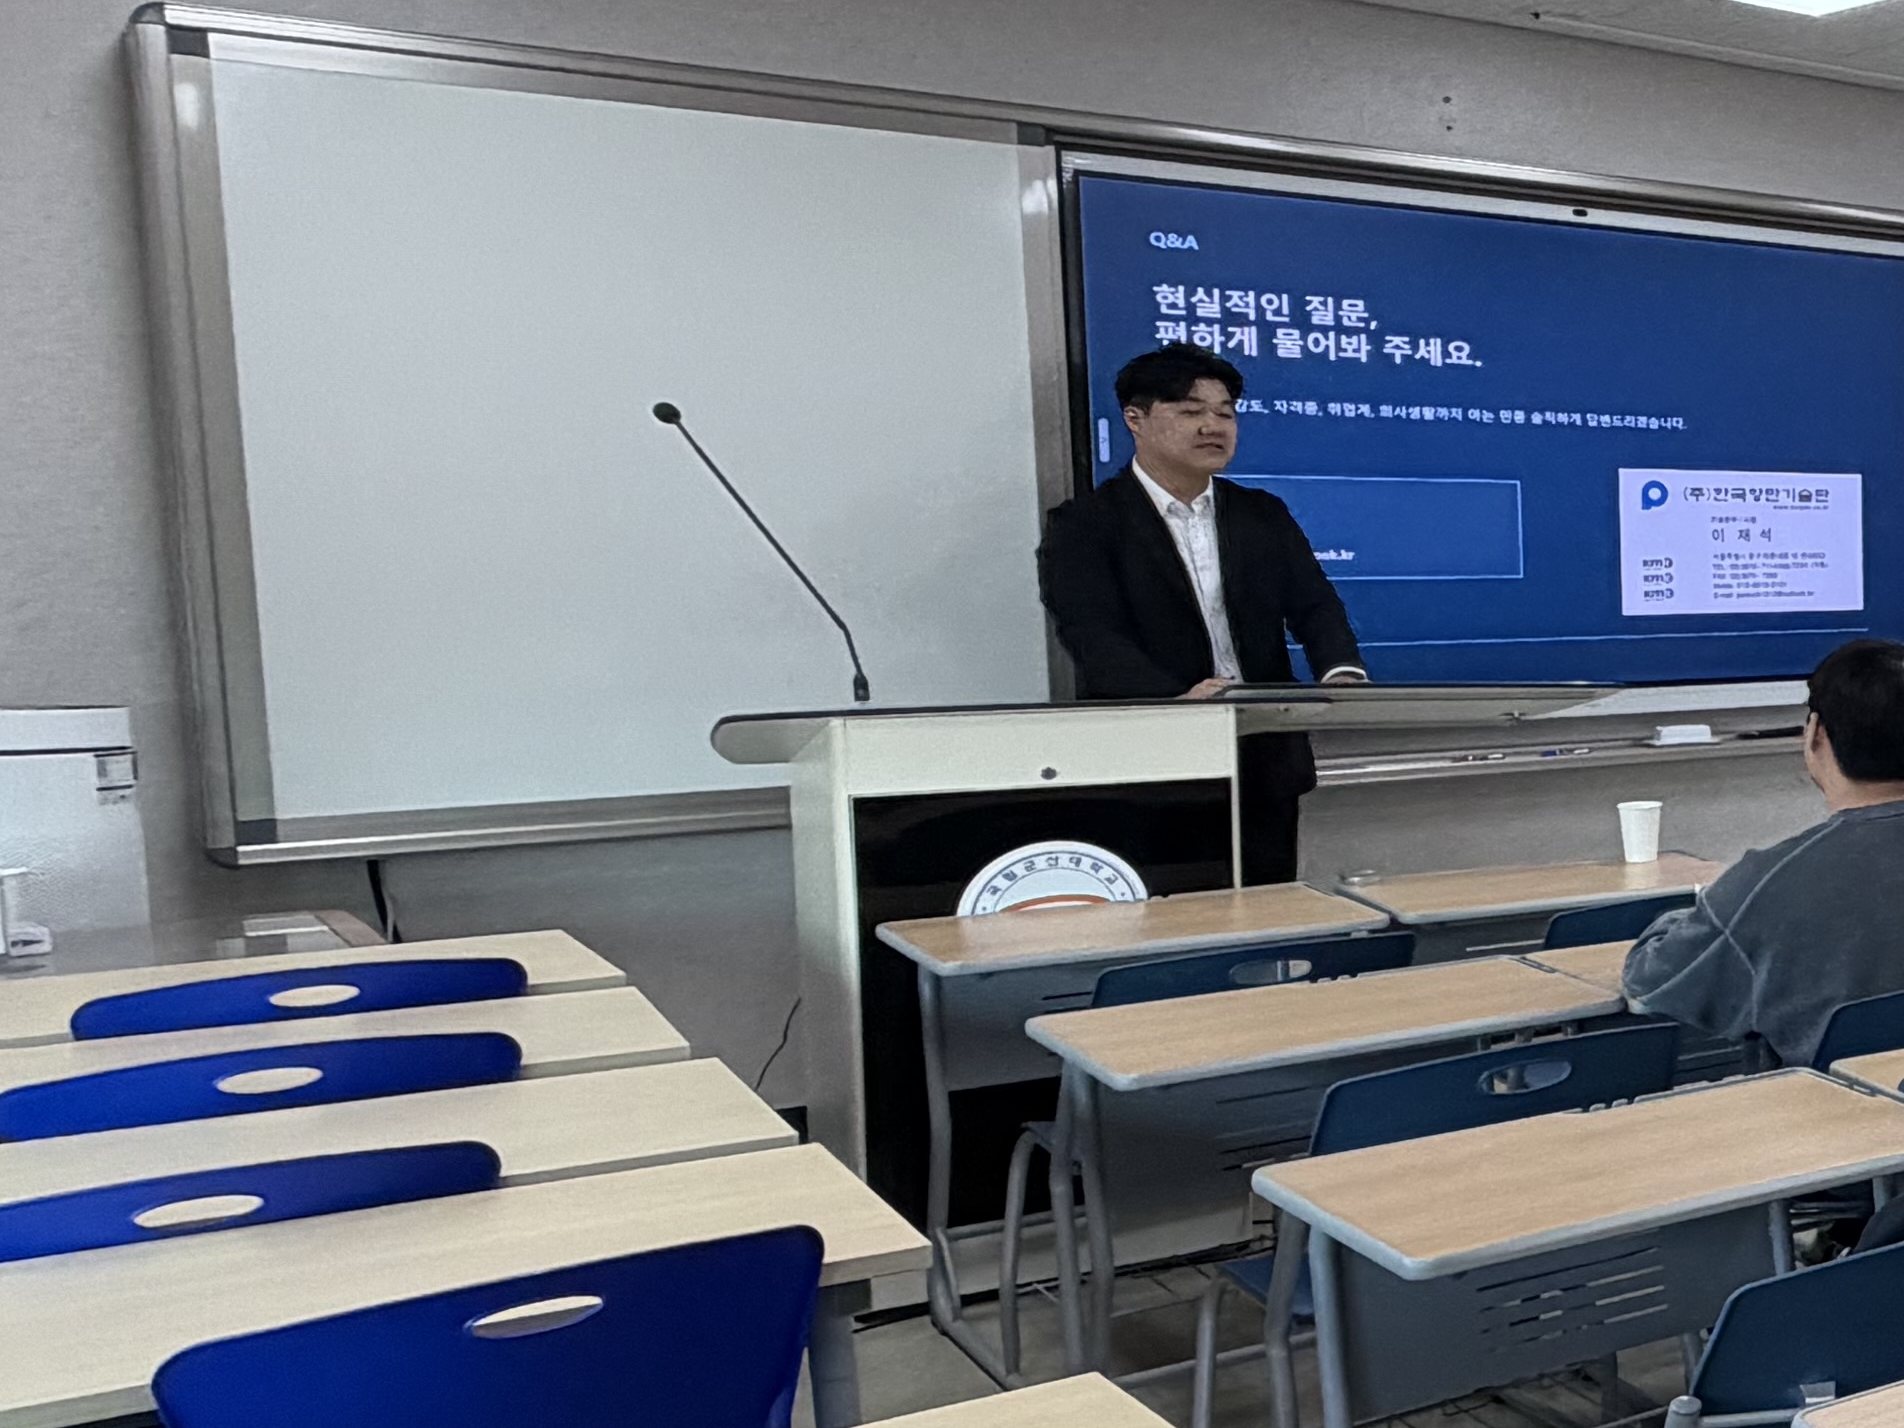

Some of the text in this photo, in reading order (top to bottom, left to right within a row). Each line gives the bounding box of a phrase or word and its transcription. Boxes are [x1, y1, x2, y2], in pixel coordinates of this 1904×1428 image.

[1149, 231, 1199, 251] Q&A
[1153, 283, 1378, 330] 현실적인 질문,
[1272, 328, 1371, 363] 물어봐
[1383, 335, 1483, 368] 주세요.
